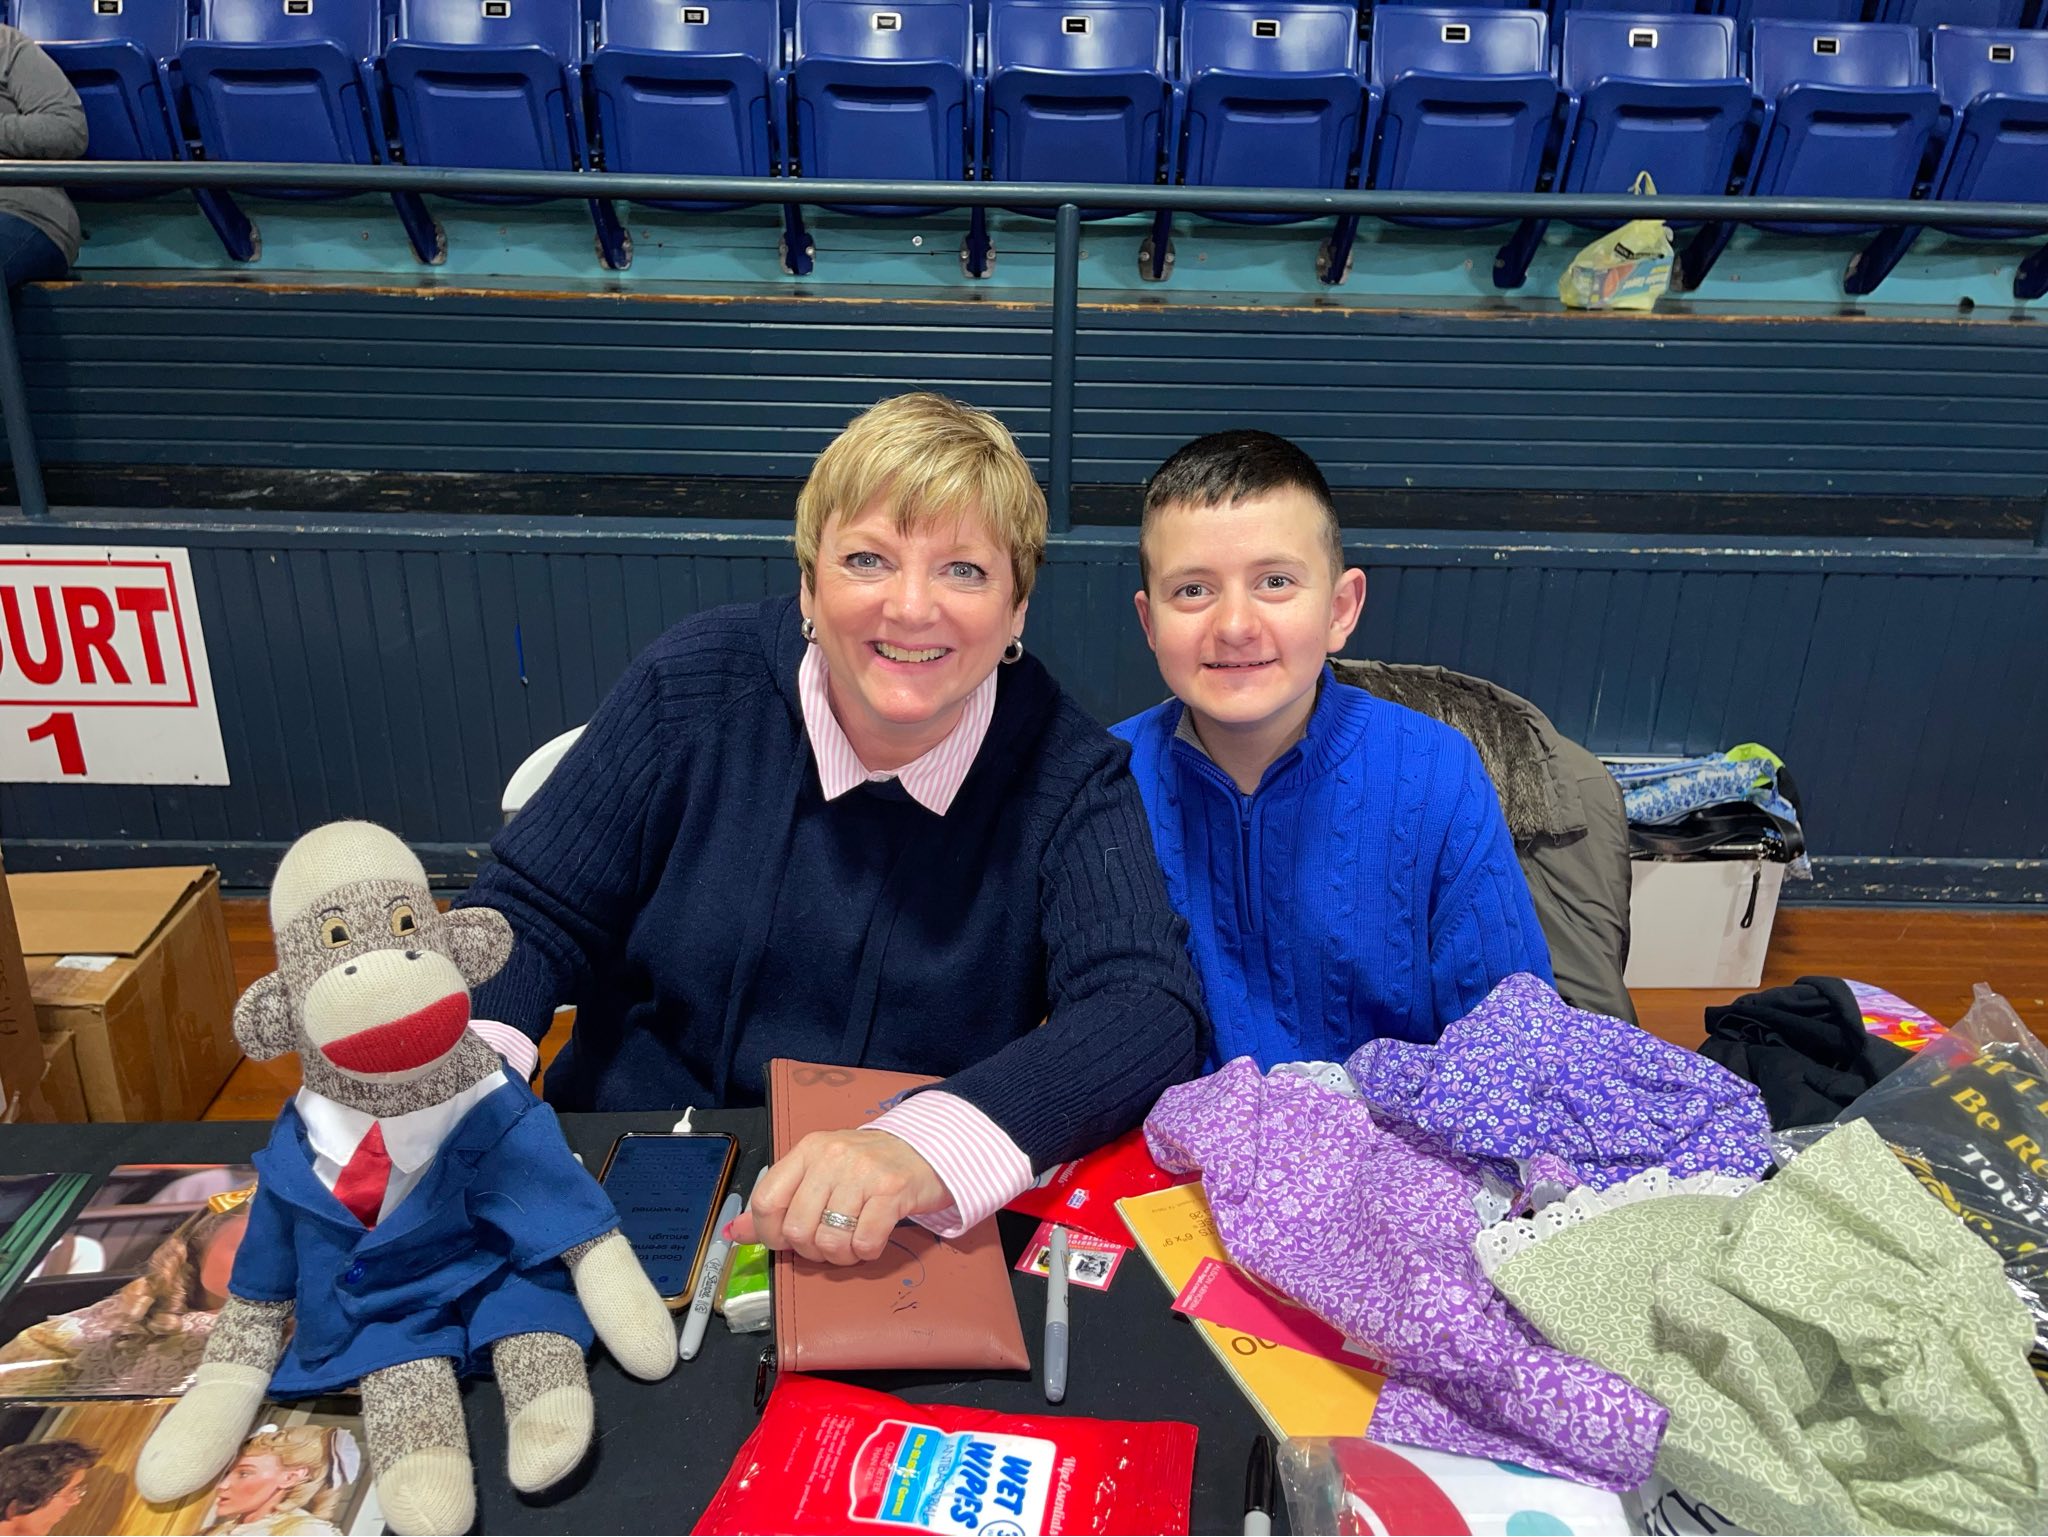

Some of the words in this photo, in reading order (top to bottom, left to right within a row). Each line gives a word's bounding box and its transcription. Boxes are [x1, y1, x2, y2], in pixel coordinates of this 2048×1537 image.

[0, 586, 169, 685] URT
[27, 712, 88, 775] 1
[1951, 1087, 2000, 1131] Be
[928, 1443, 955, 1518] ANTIBACTERIAL
[950, 1441, 996, 1529] WIPES
[993, 1455, 1032, 1516] WET
